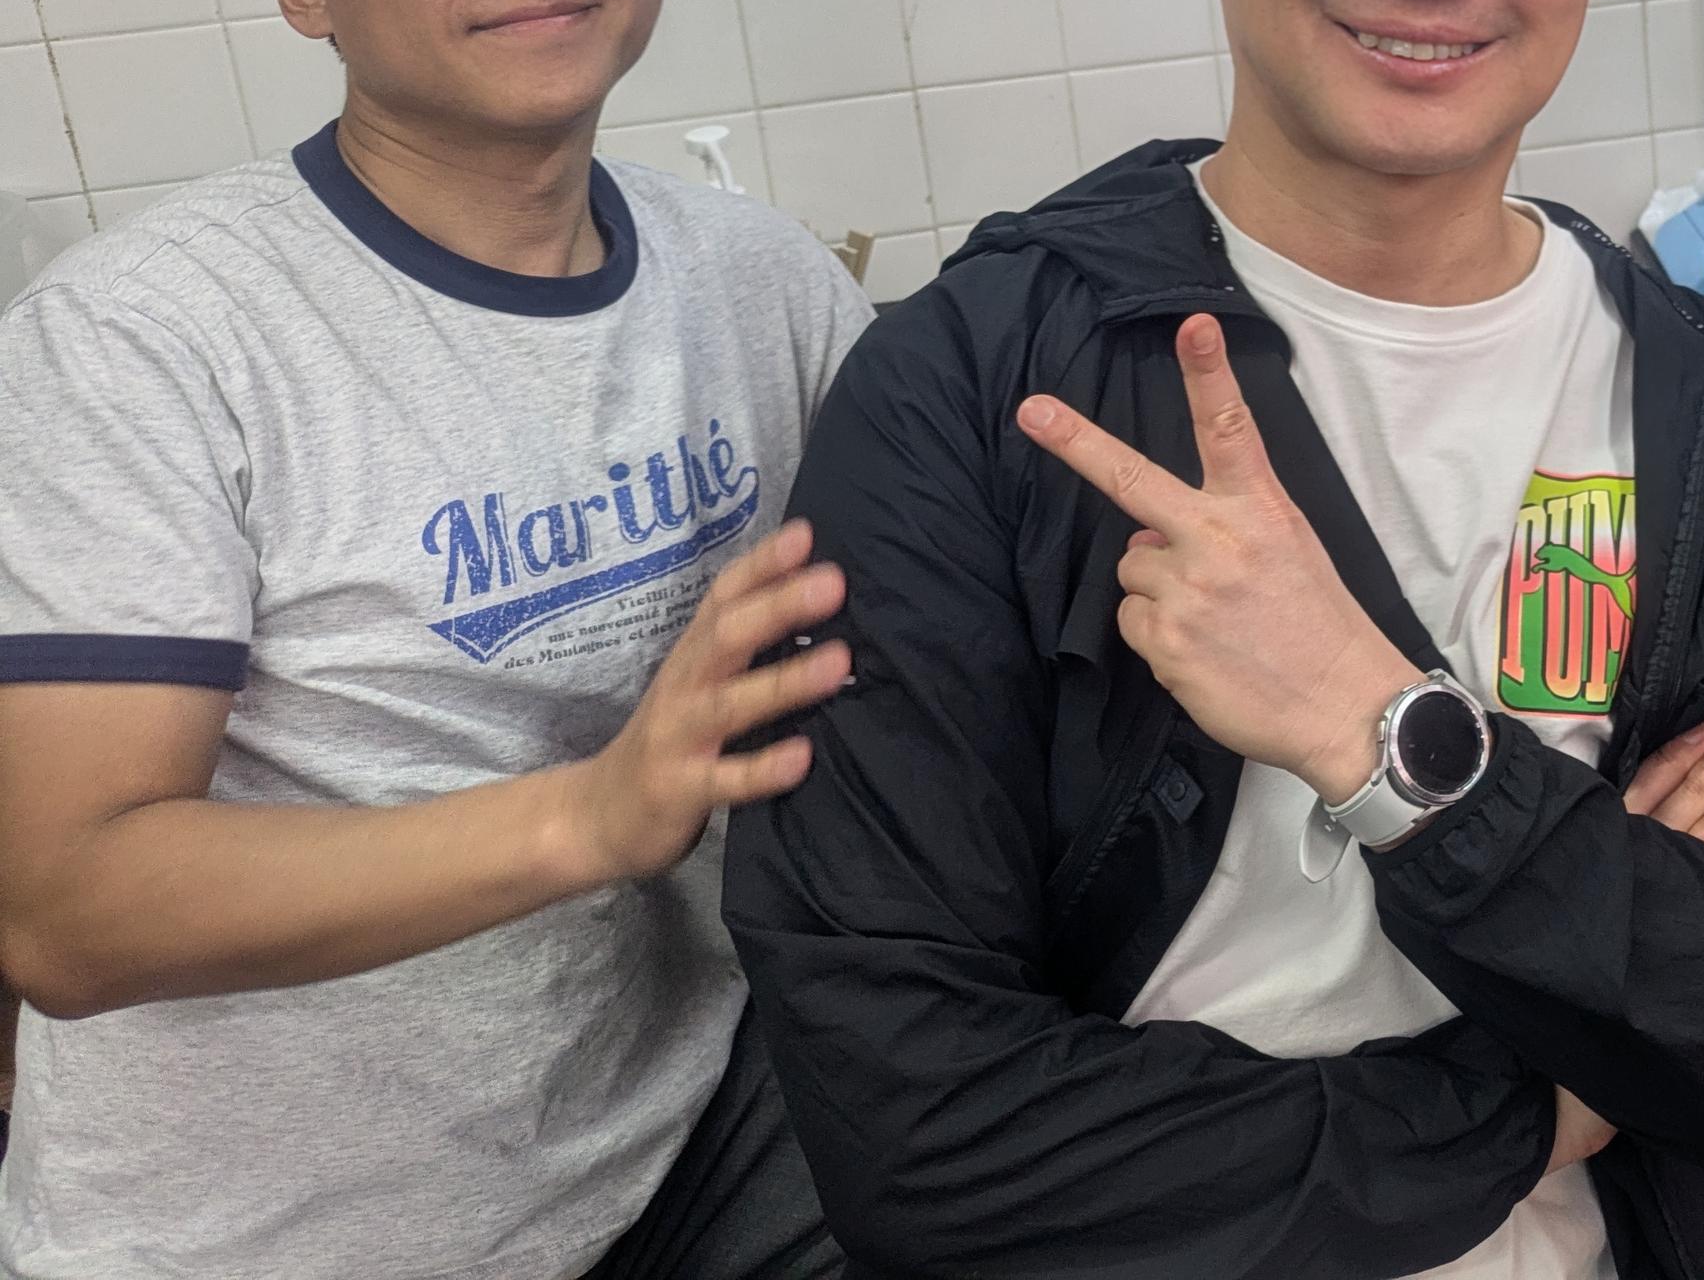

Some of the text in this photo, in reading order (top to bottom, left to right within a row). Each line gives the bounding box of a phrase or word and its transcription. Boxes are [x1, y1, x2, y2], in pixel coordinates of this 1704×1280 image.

[421, 419, 738, 605] Marithé
[617, 587, 676, 612] Vieillir
[504, 627, 645, 671] des Montagnes et
[549, 629, 574, 645] une
